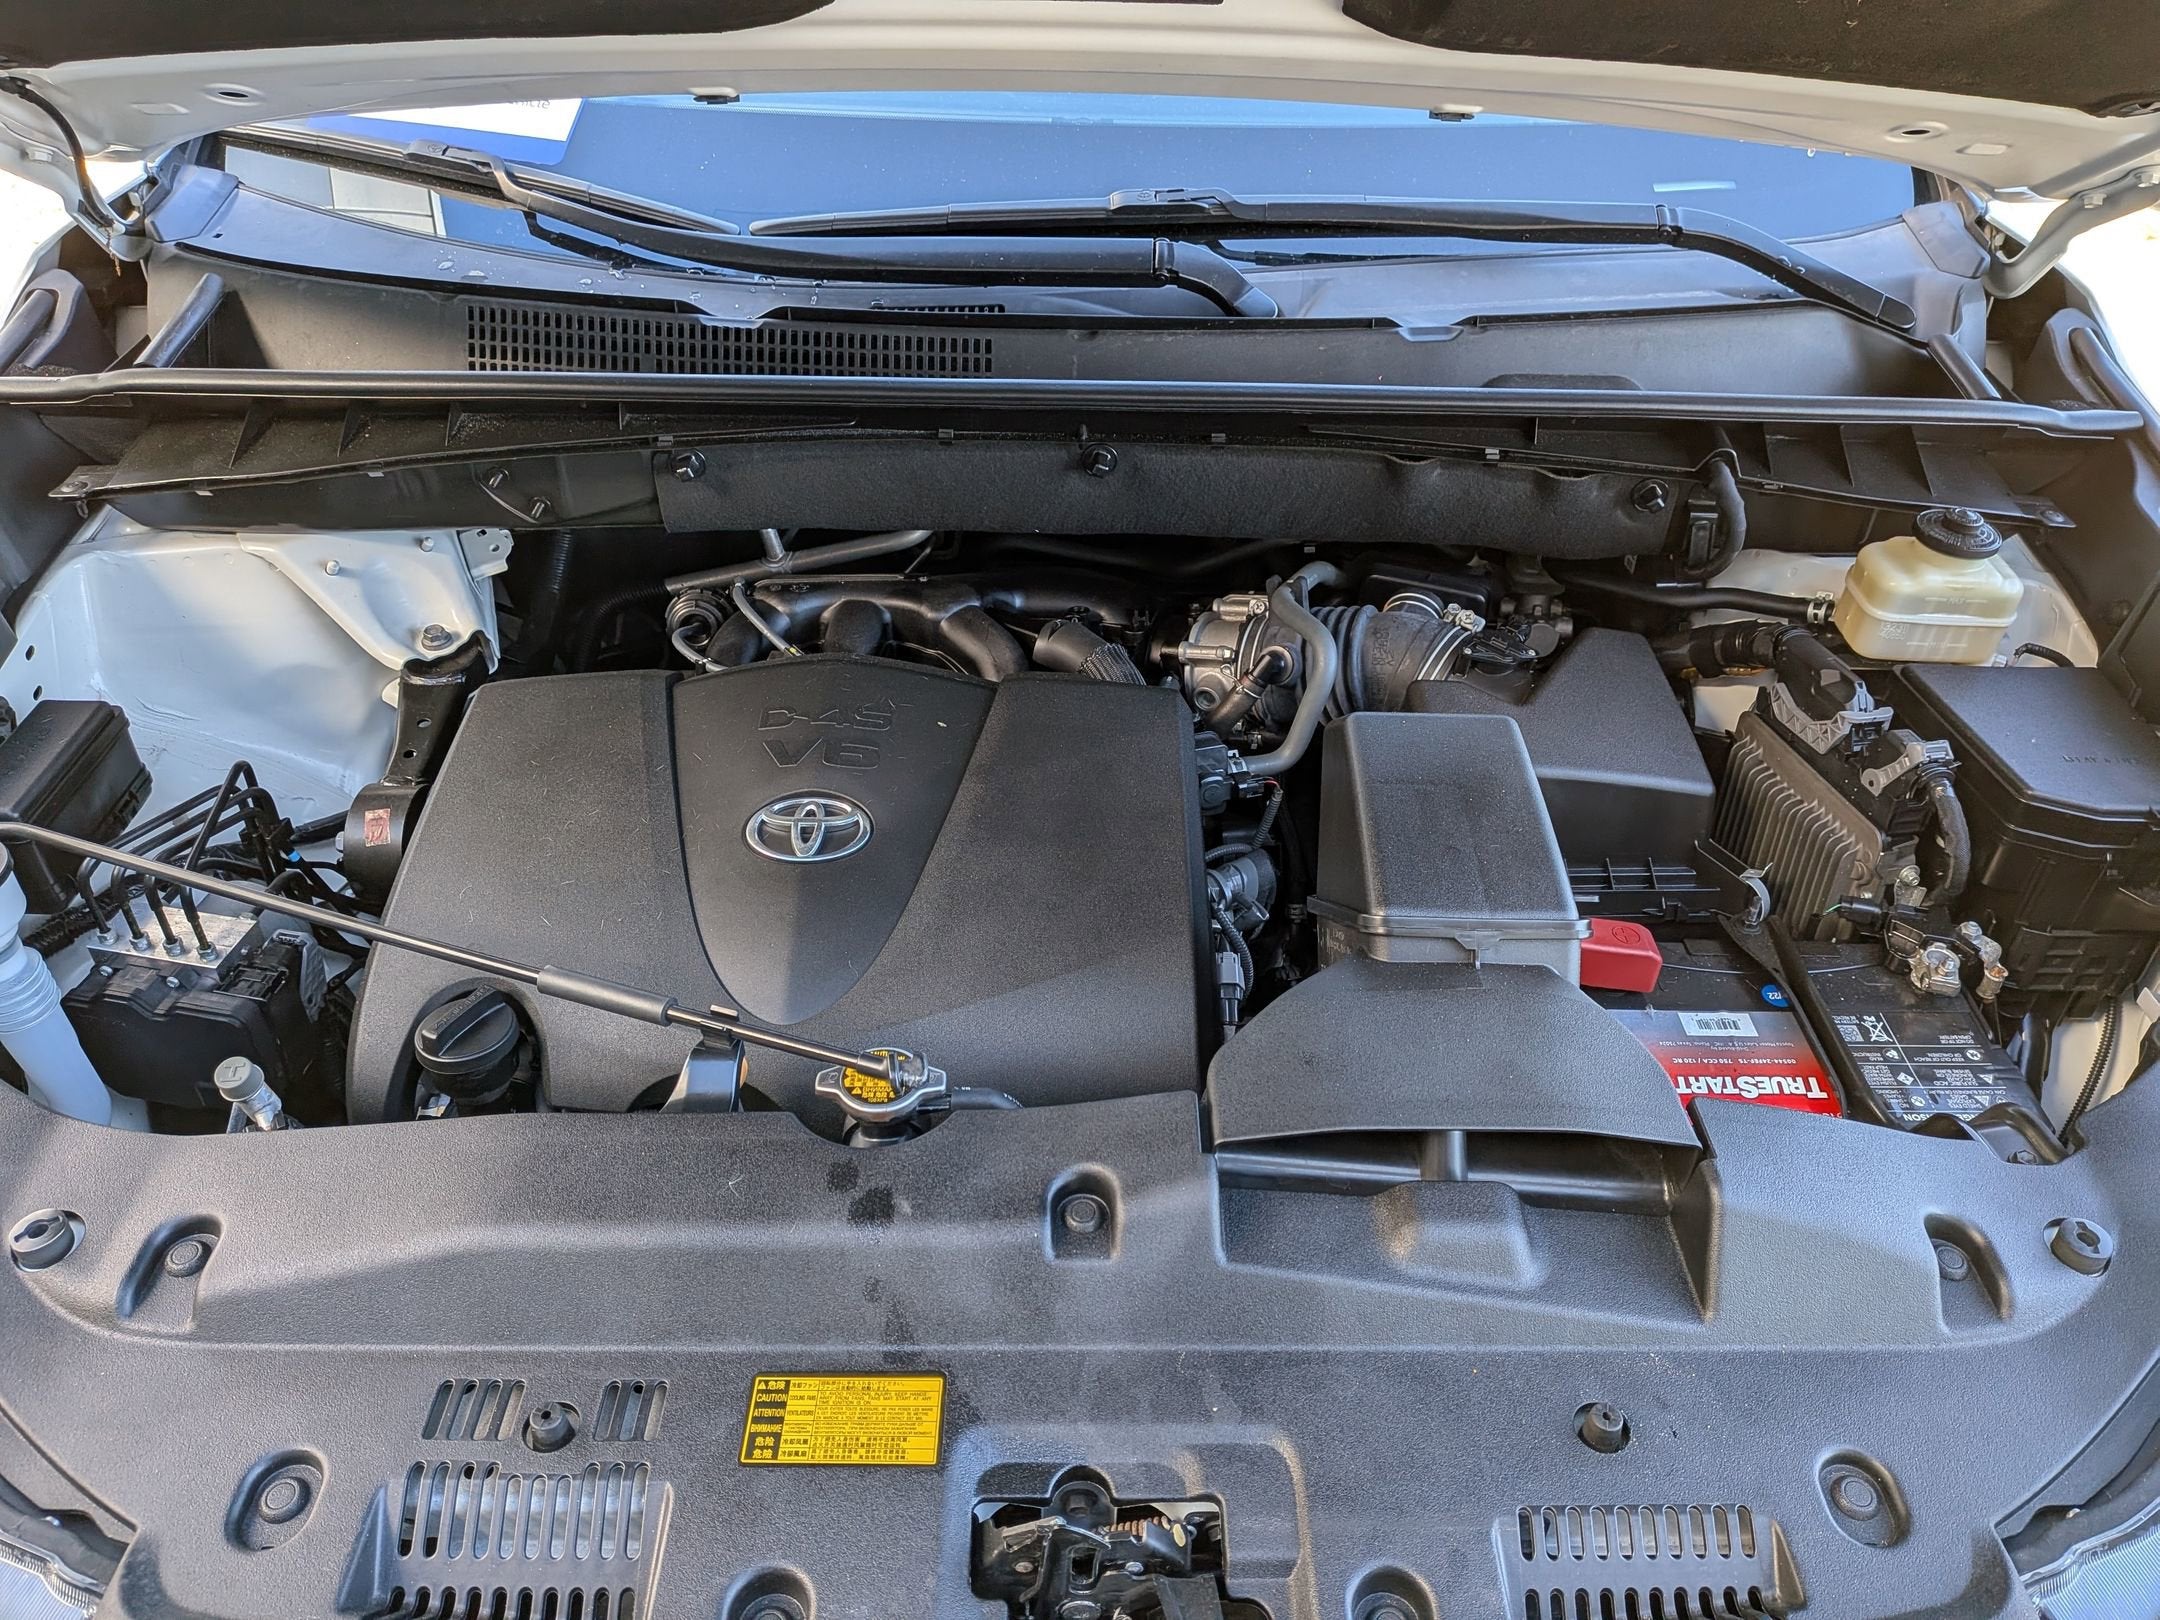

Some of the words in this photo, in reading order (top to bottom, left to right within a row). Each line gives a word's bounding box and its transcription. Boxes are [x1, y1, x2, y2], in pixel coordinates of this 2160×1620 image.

[758, 708, 892, 731] D-4S
[762, 739, 880, 769] V6
[756, 1393, 788, 1402] CAUTION
[753, 1408, 785, 1417] ATTENTION
[750, 1423, 782, 1433] ВНИМАНИЕ
